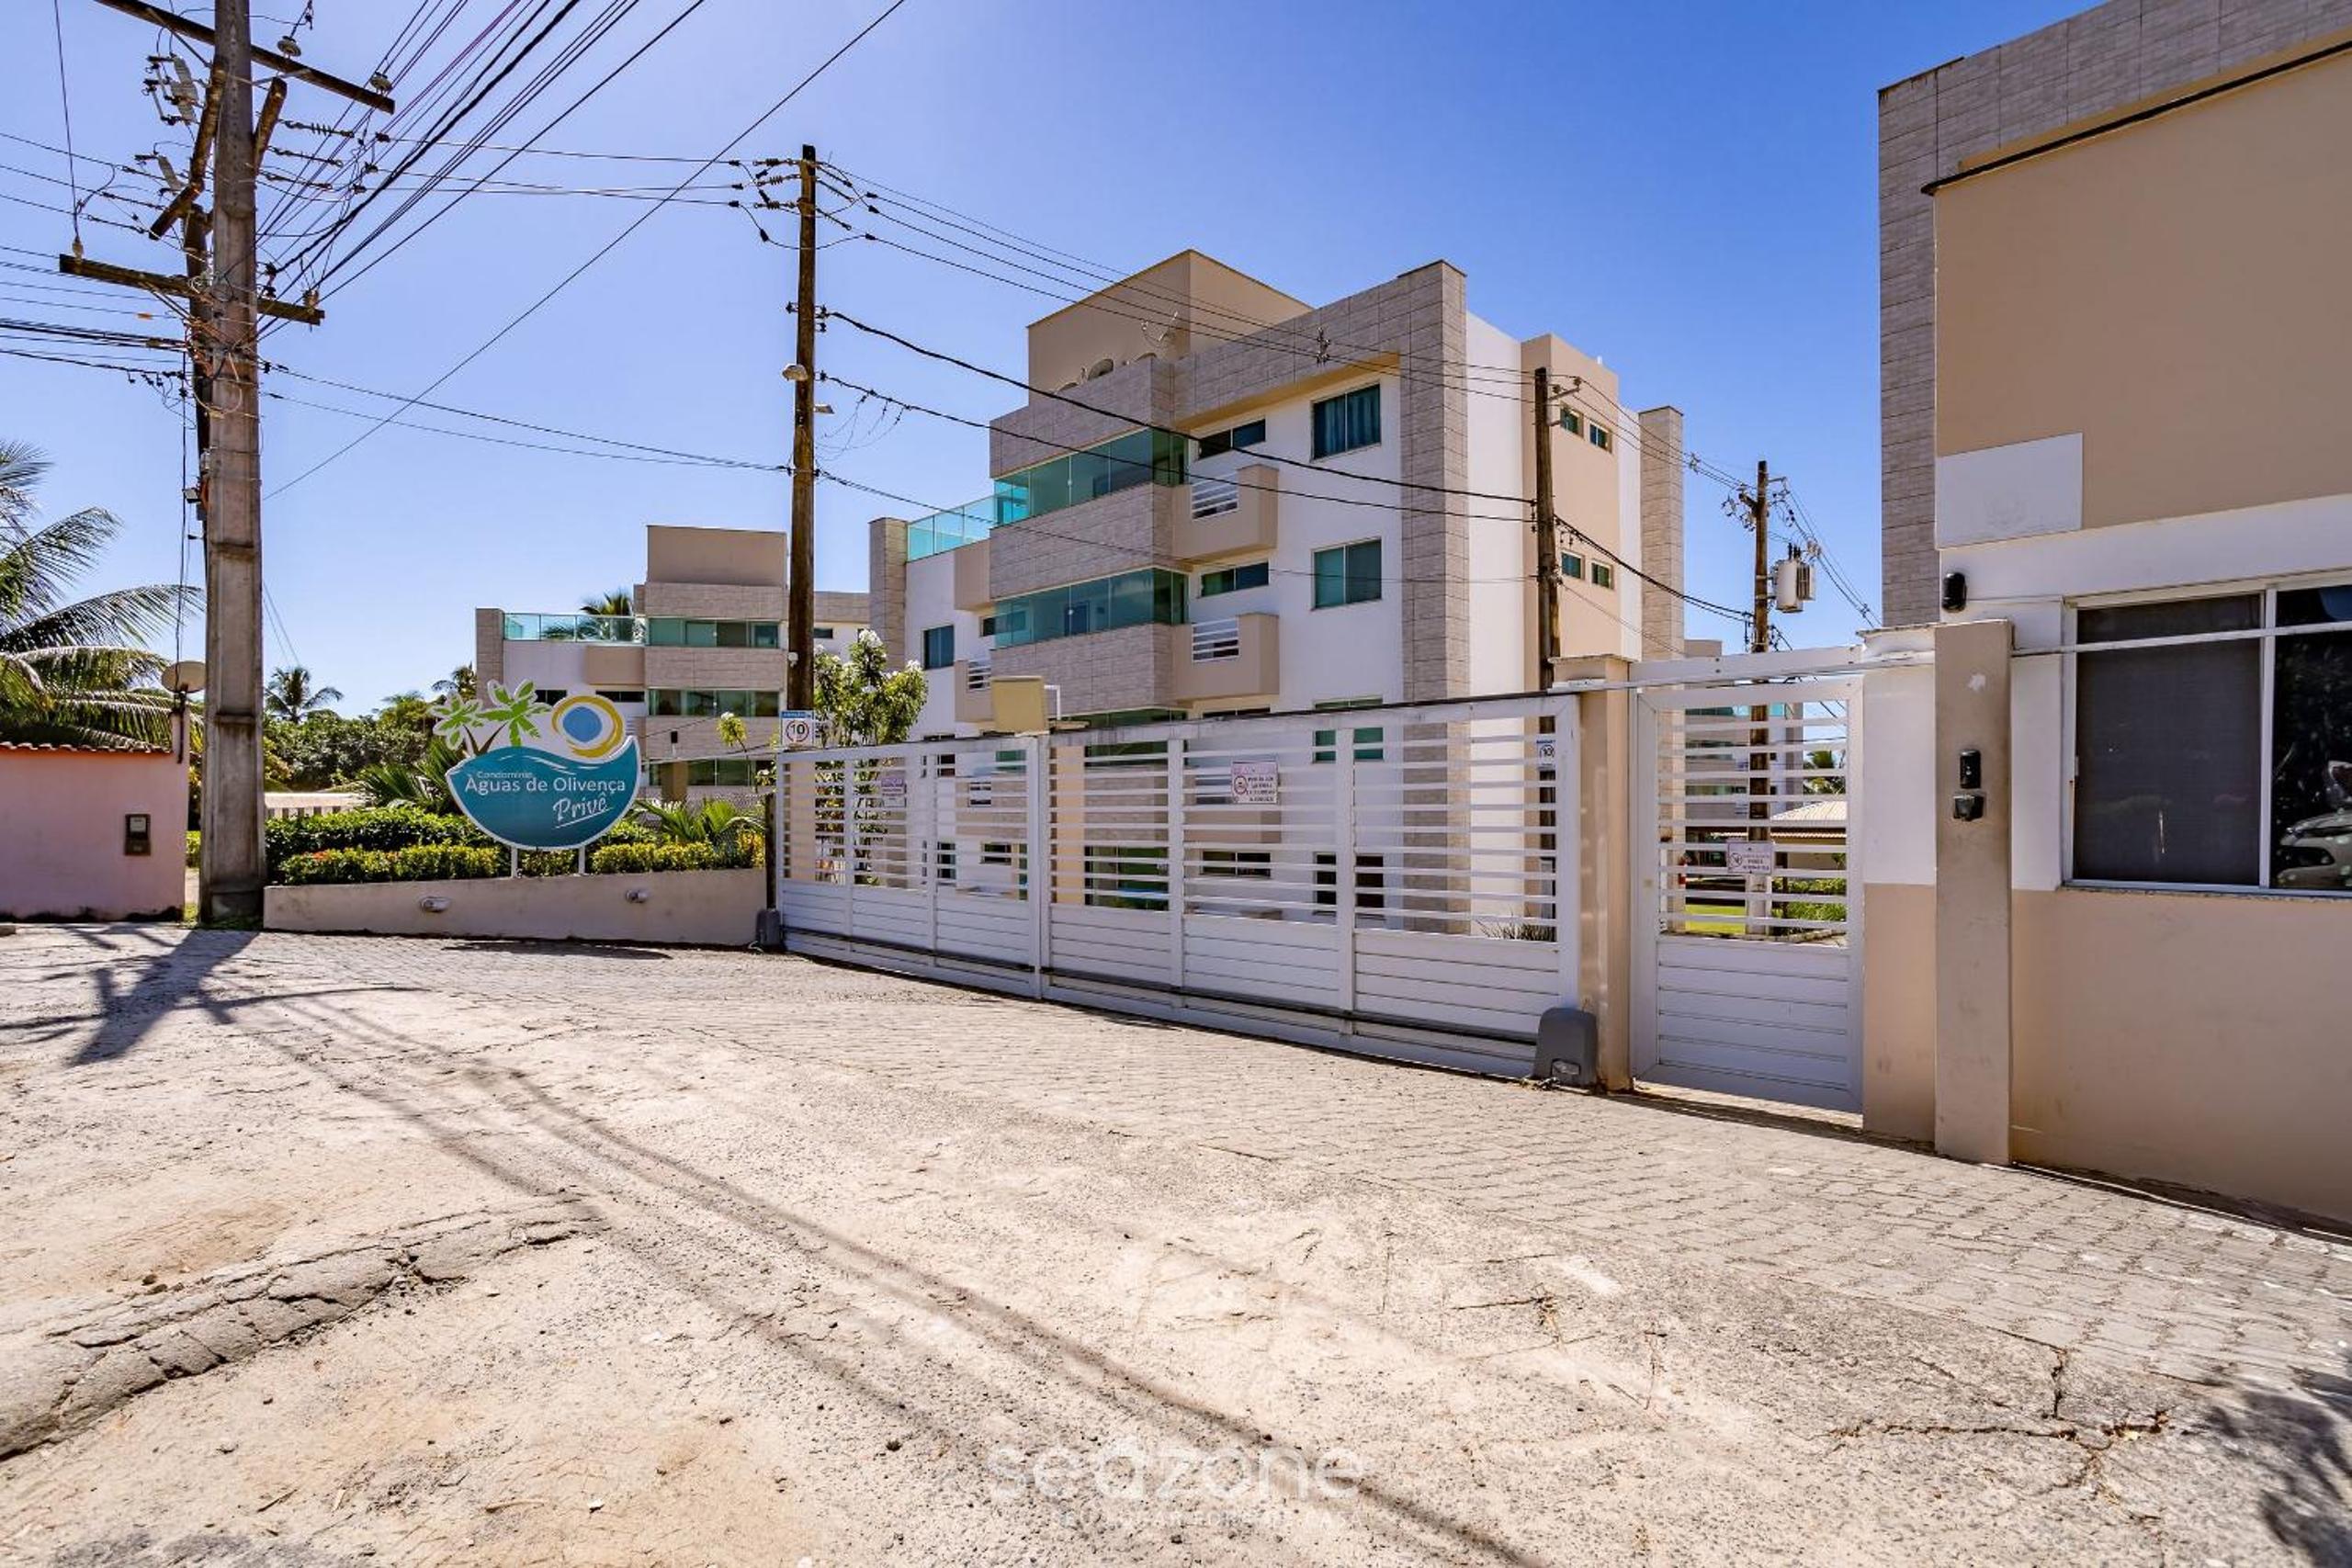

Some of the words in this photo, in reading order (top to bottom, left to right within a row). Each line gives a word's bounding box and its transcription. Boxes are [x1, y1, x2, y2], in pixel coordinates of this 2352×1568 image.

[790, 724, 806, 735] 10
[526, 777, 548, 792] de
[552, 777, 626, 794] Olivença
[552, 791, 608, 822] Privê
